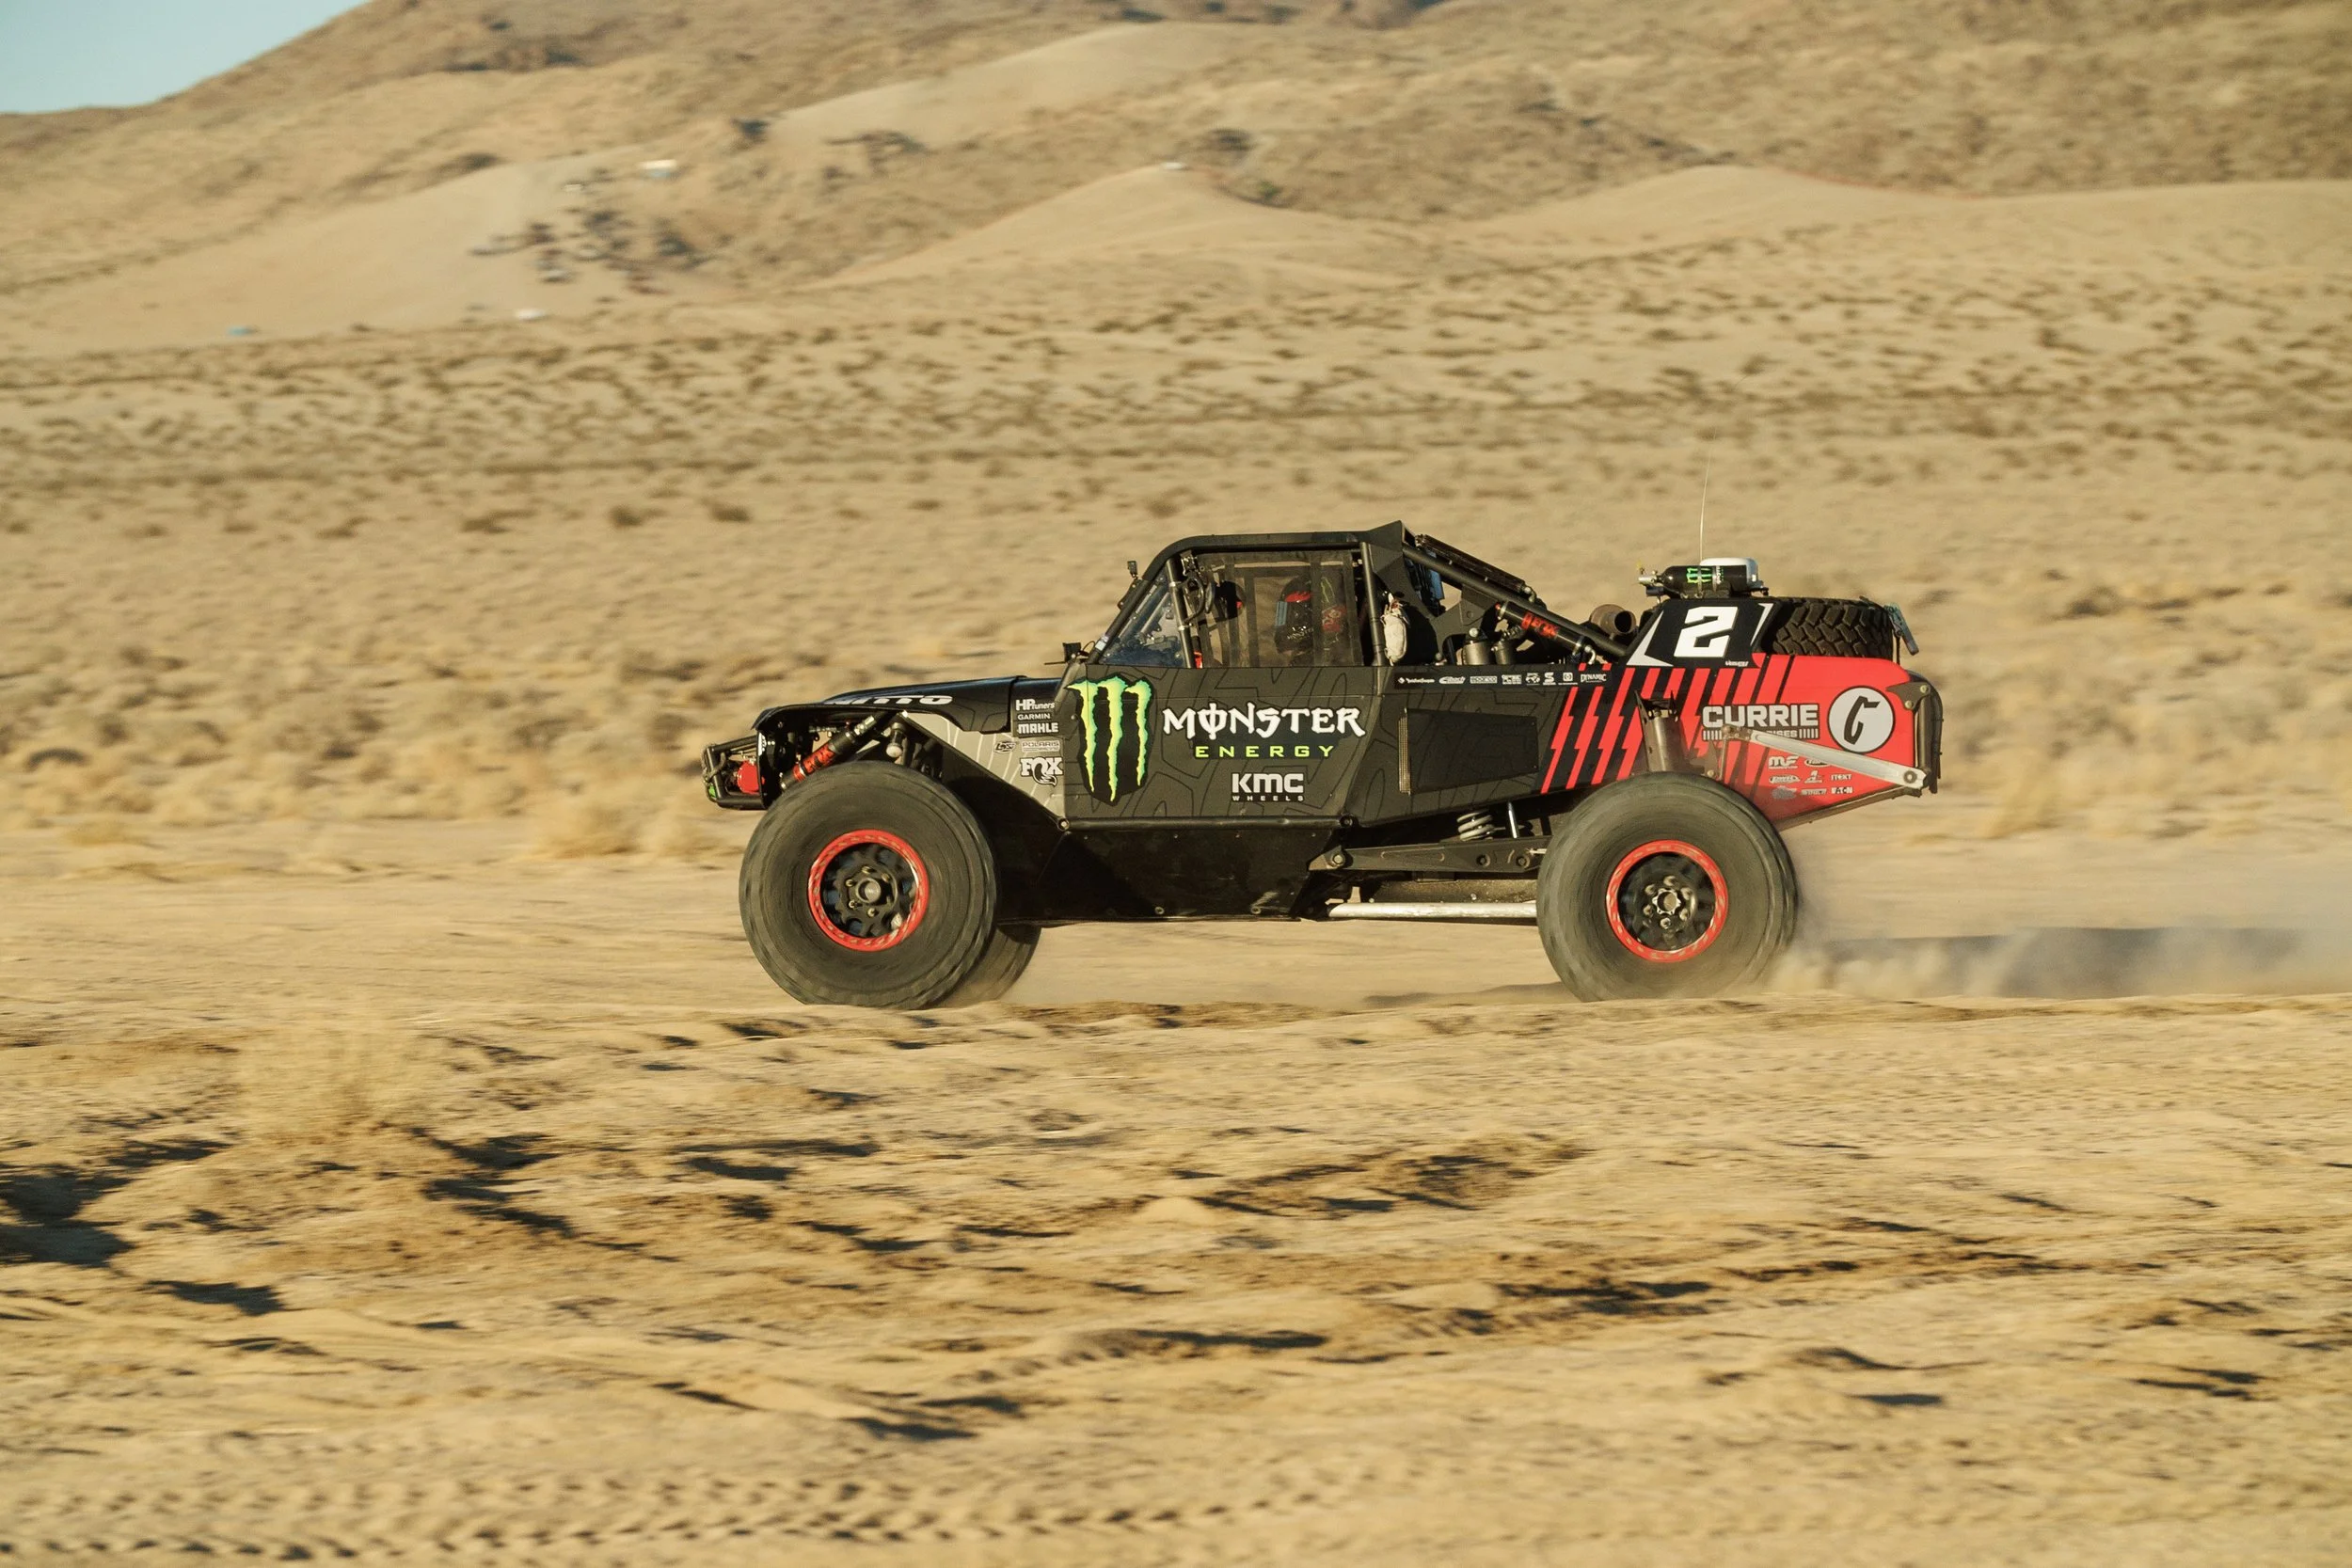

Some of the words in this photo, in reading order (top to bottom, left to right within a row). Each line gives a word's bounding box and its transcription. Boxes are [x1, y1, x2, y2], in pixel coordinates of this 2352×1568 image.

[1674, 607, 1738, 657] 2
[1018, 722, 1058, 734] MAHLE
[1162, 702, 1365, 740] MONSTER
[1703, 705, 1819, 728] CURRIE
[1195, 746, 1334, 757] ENERGY
[1020, 756, 1063, 783] FOX
[1232, 773, 1304, 793] KMC
